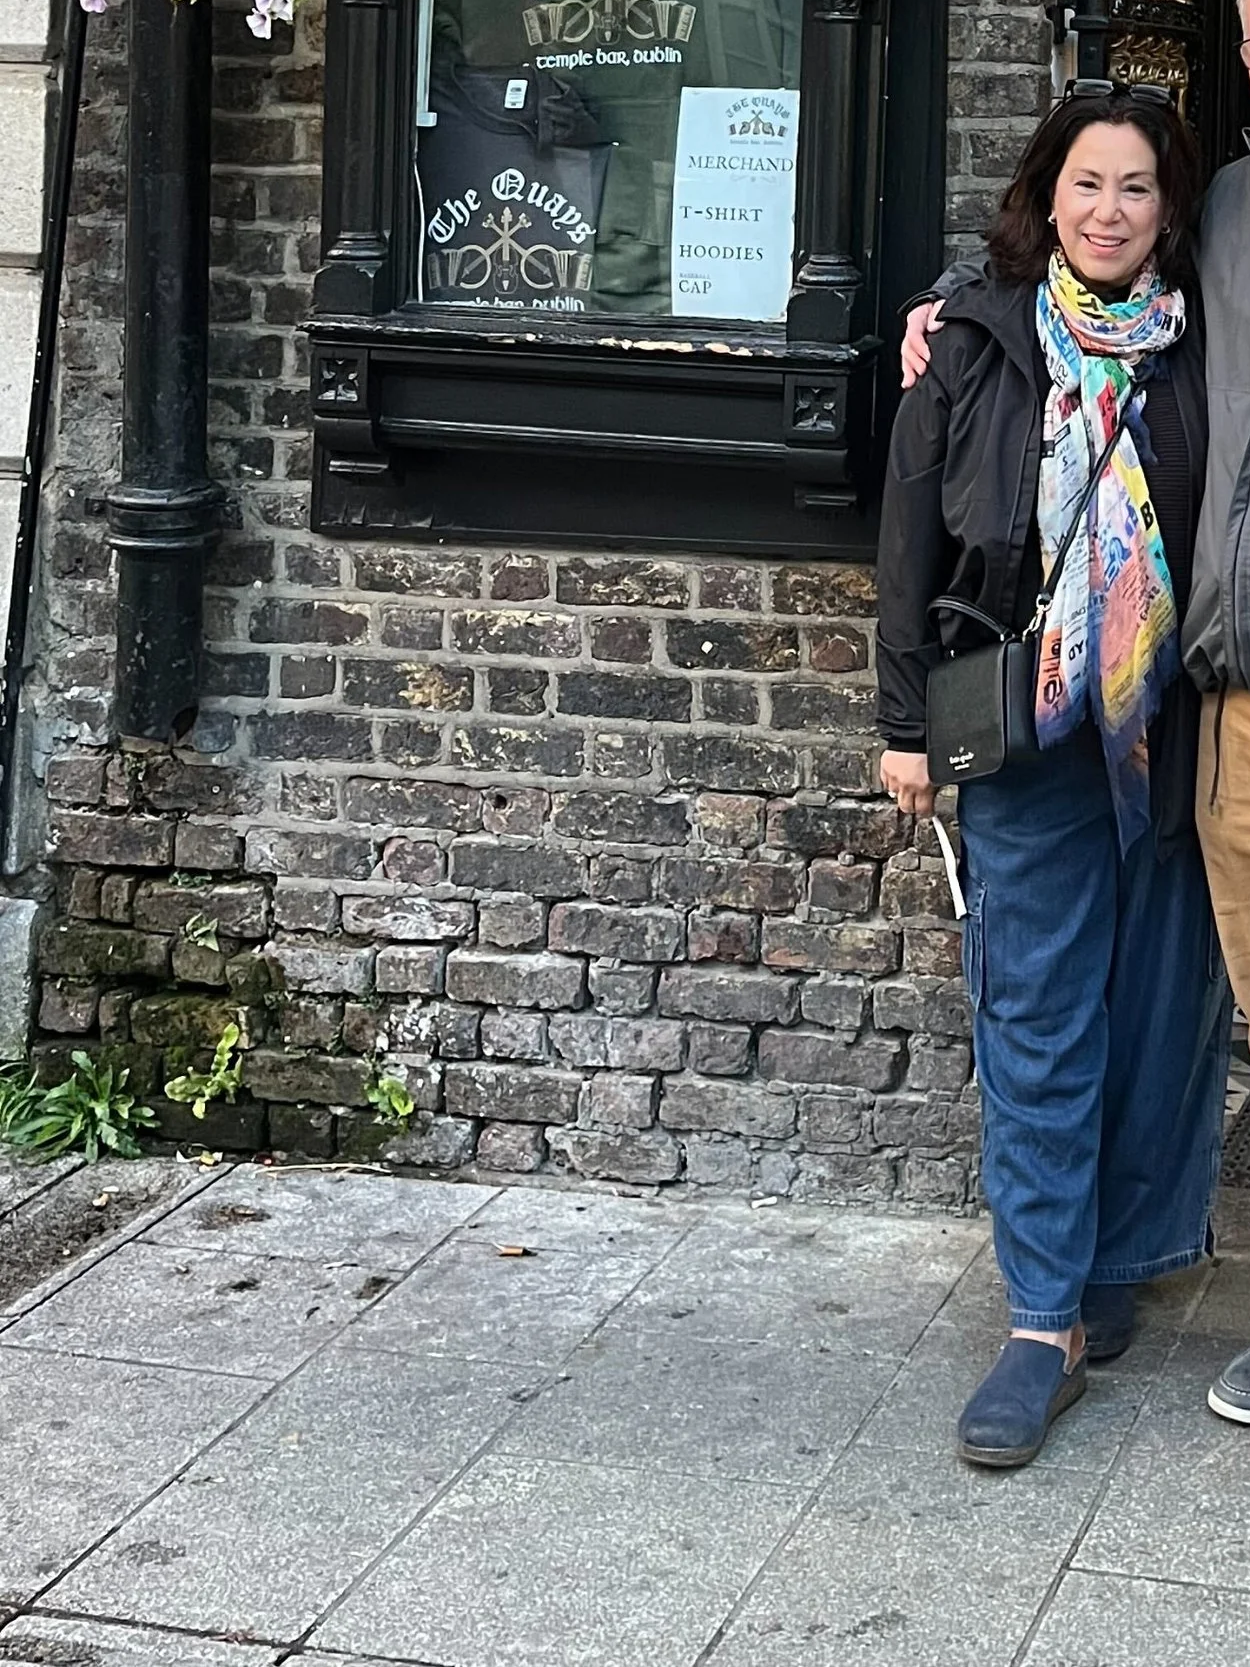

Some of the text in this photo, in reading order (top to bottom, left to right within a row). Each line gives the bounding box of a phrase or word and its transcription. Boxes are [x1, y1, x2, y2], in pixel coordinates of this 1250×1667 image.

[536, 49, 593, 70] temple
[633, 46, 682, 64] dublin
[688, 155, 794, 172] MERCHAND
[428, 168, 597, 244] The Quays
[679, 206, 763, 222] T-SHIRT
[679, 244, 764, 261] HOODIES
[679, 279, 712, 294] CAP
